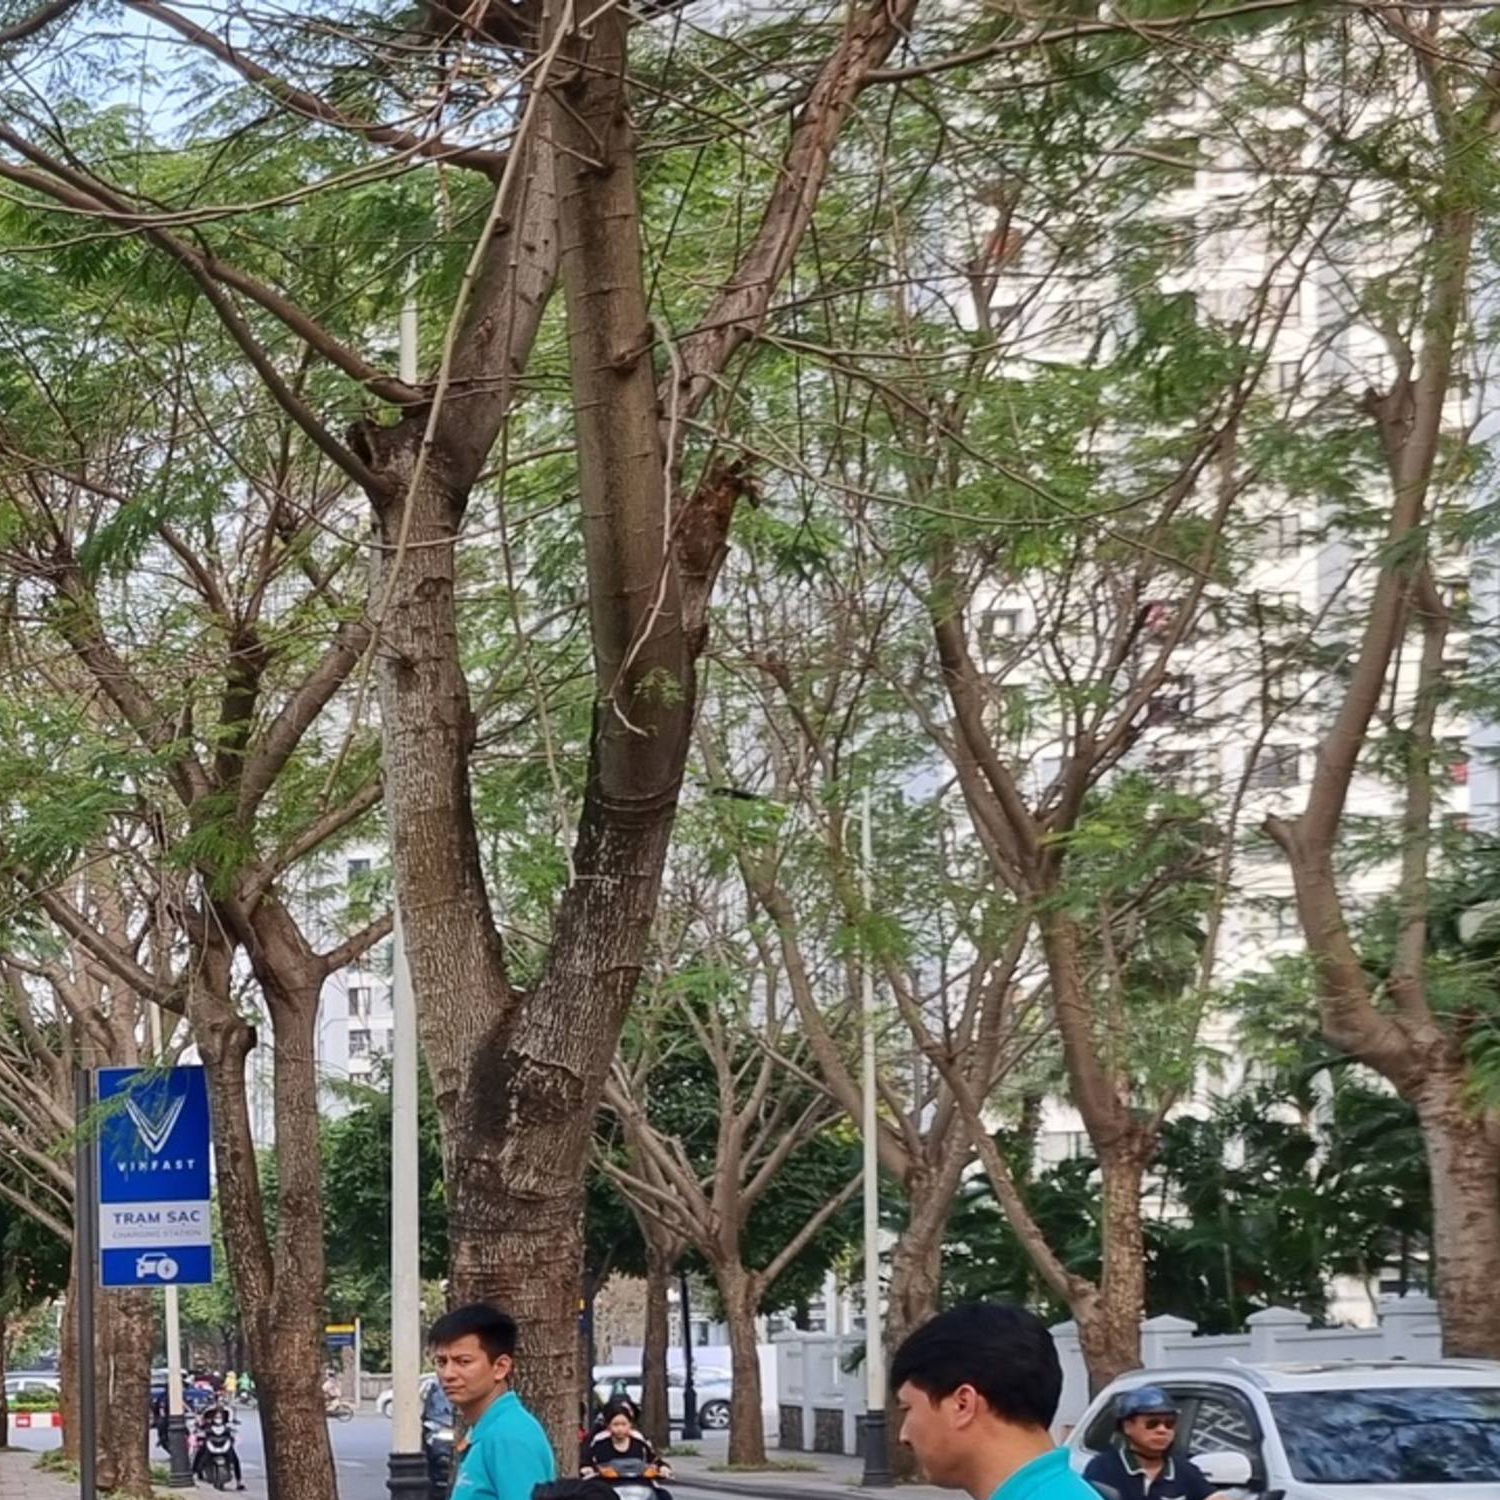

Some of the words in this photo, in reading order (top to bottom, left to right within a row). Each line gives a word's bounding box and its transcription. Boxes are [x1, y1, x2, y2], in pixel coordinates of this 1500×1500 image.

[117, 1158, 196, 1173] VINFAST
[112, 1211, 161, 1228] TRẠM
[166, 1209, 201, 1227] SẠC
